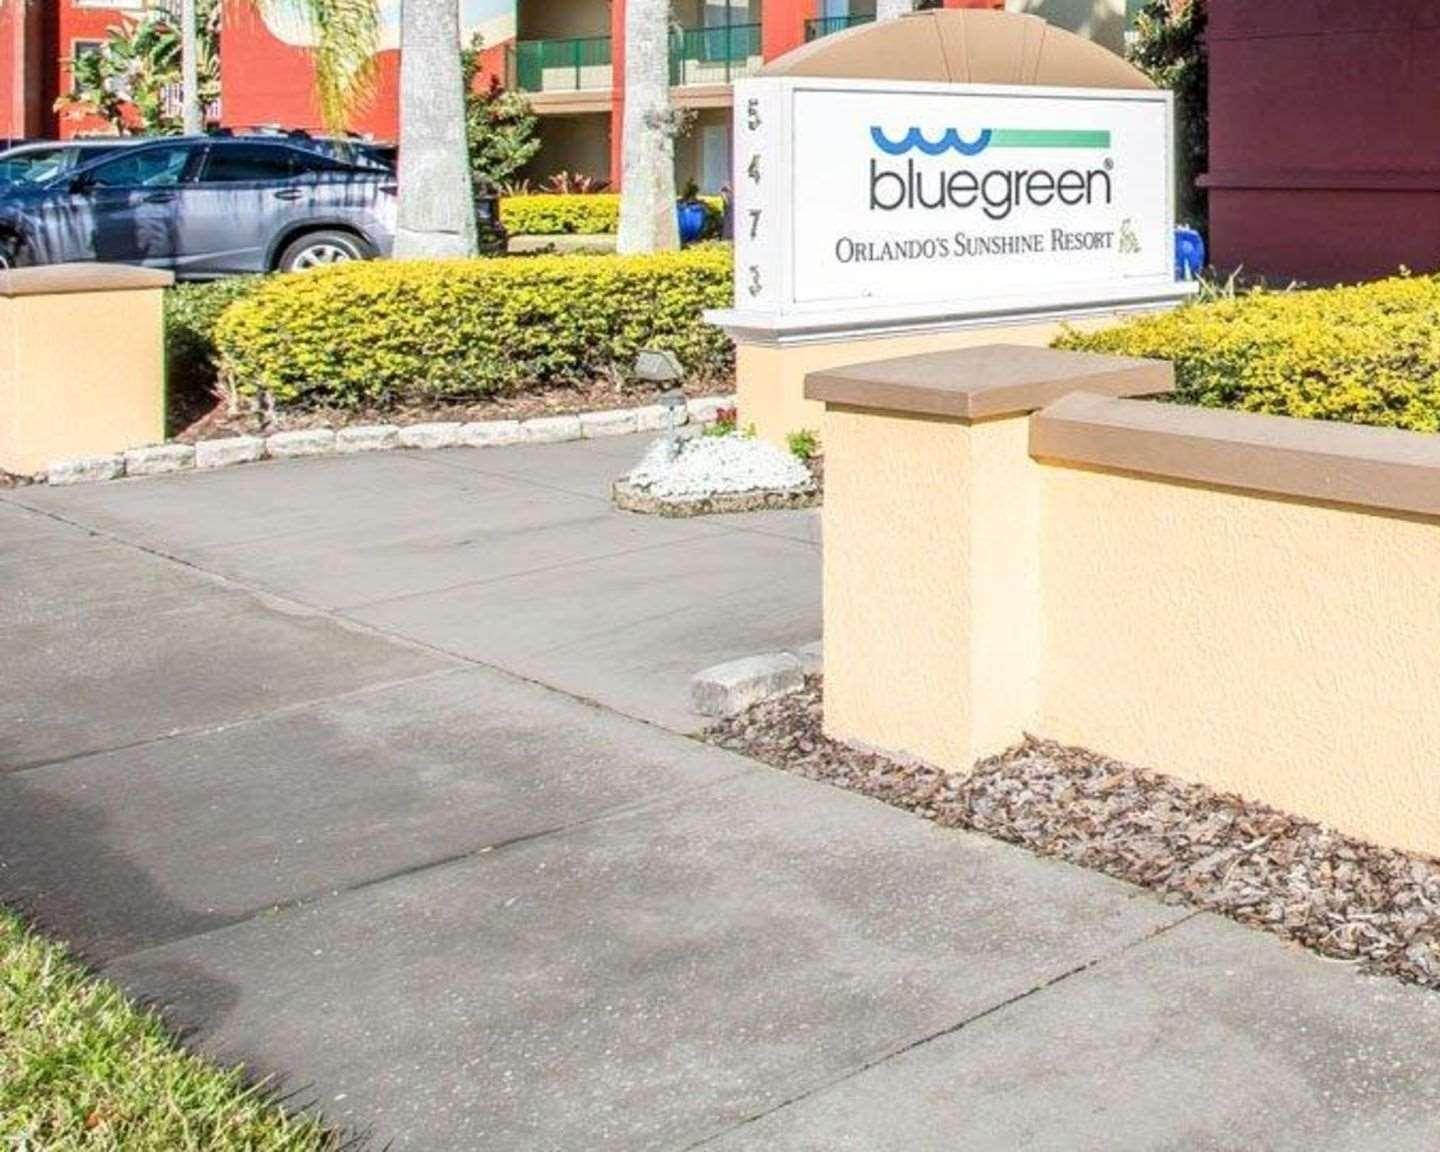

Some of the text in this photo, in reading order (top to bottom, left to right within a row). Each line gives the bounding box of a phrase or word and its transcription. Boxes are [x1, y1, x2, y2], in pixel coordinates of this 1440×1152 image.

[834, 227, 1115, 263] ORLANDO'S SUNSHINE RESORT
